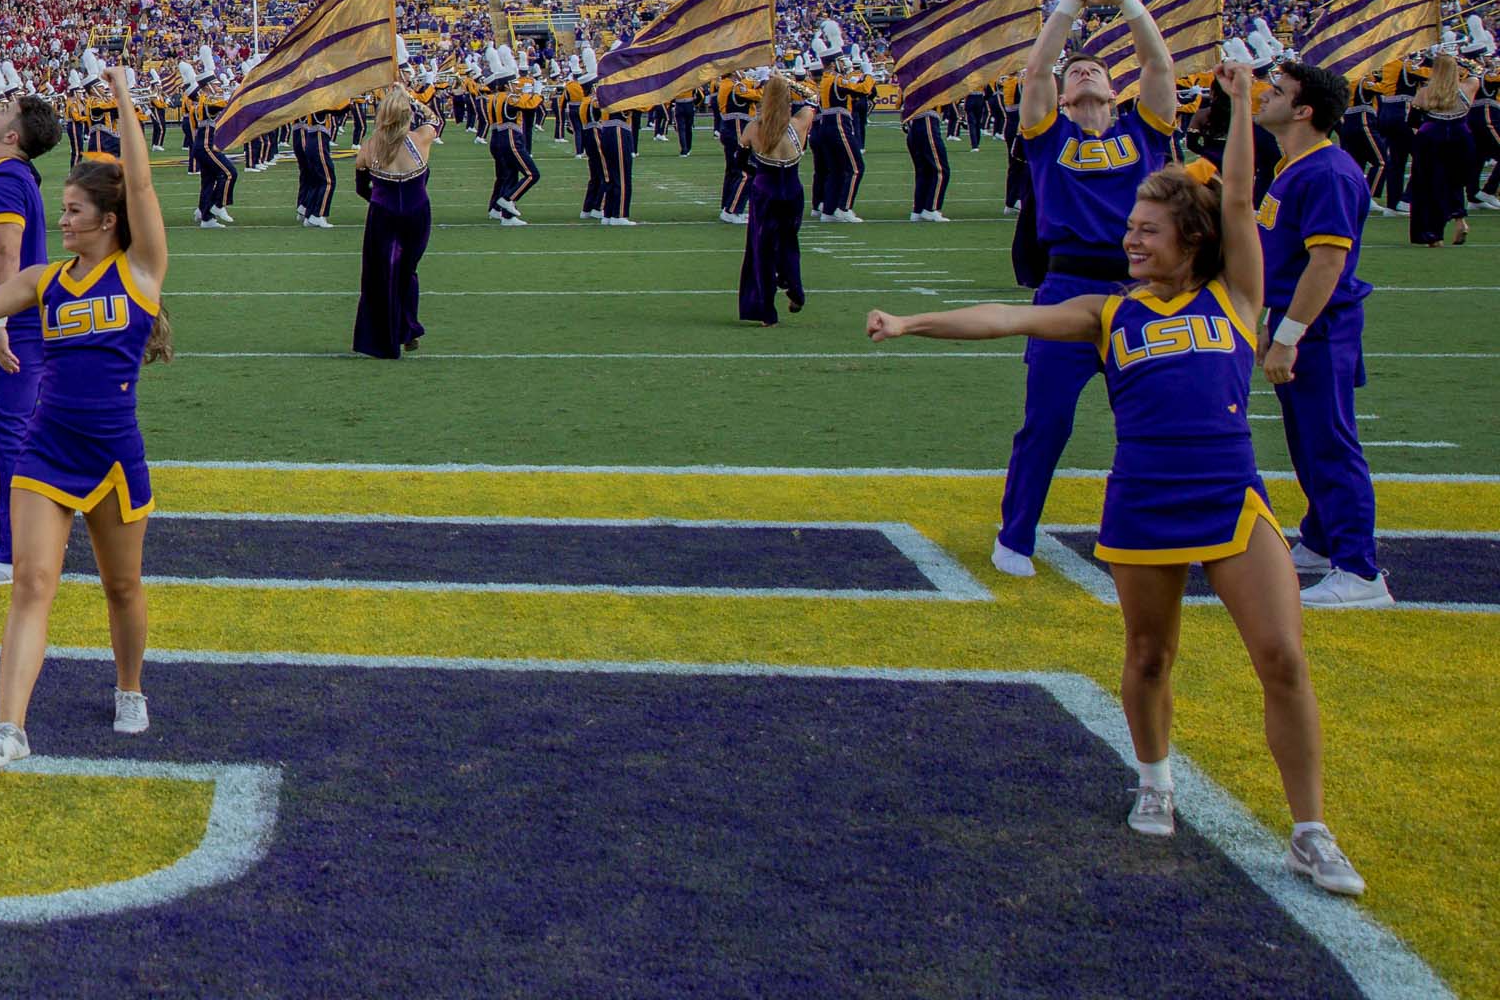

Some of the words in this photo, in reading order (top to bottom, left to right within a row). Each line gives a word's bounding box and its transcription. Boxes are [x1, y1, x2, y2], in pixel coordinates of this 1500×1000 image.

[1057, 134, 1140, 171] LSU
[42, 294, 129, 341] LSU
[1111, 315, 1236, 371] LSU
